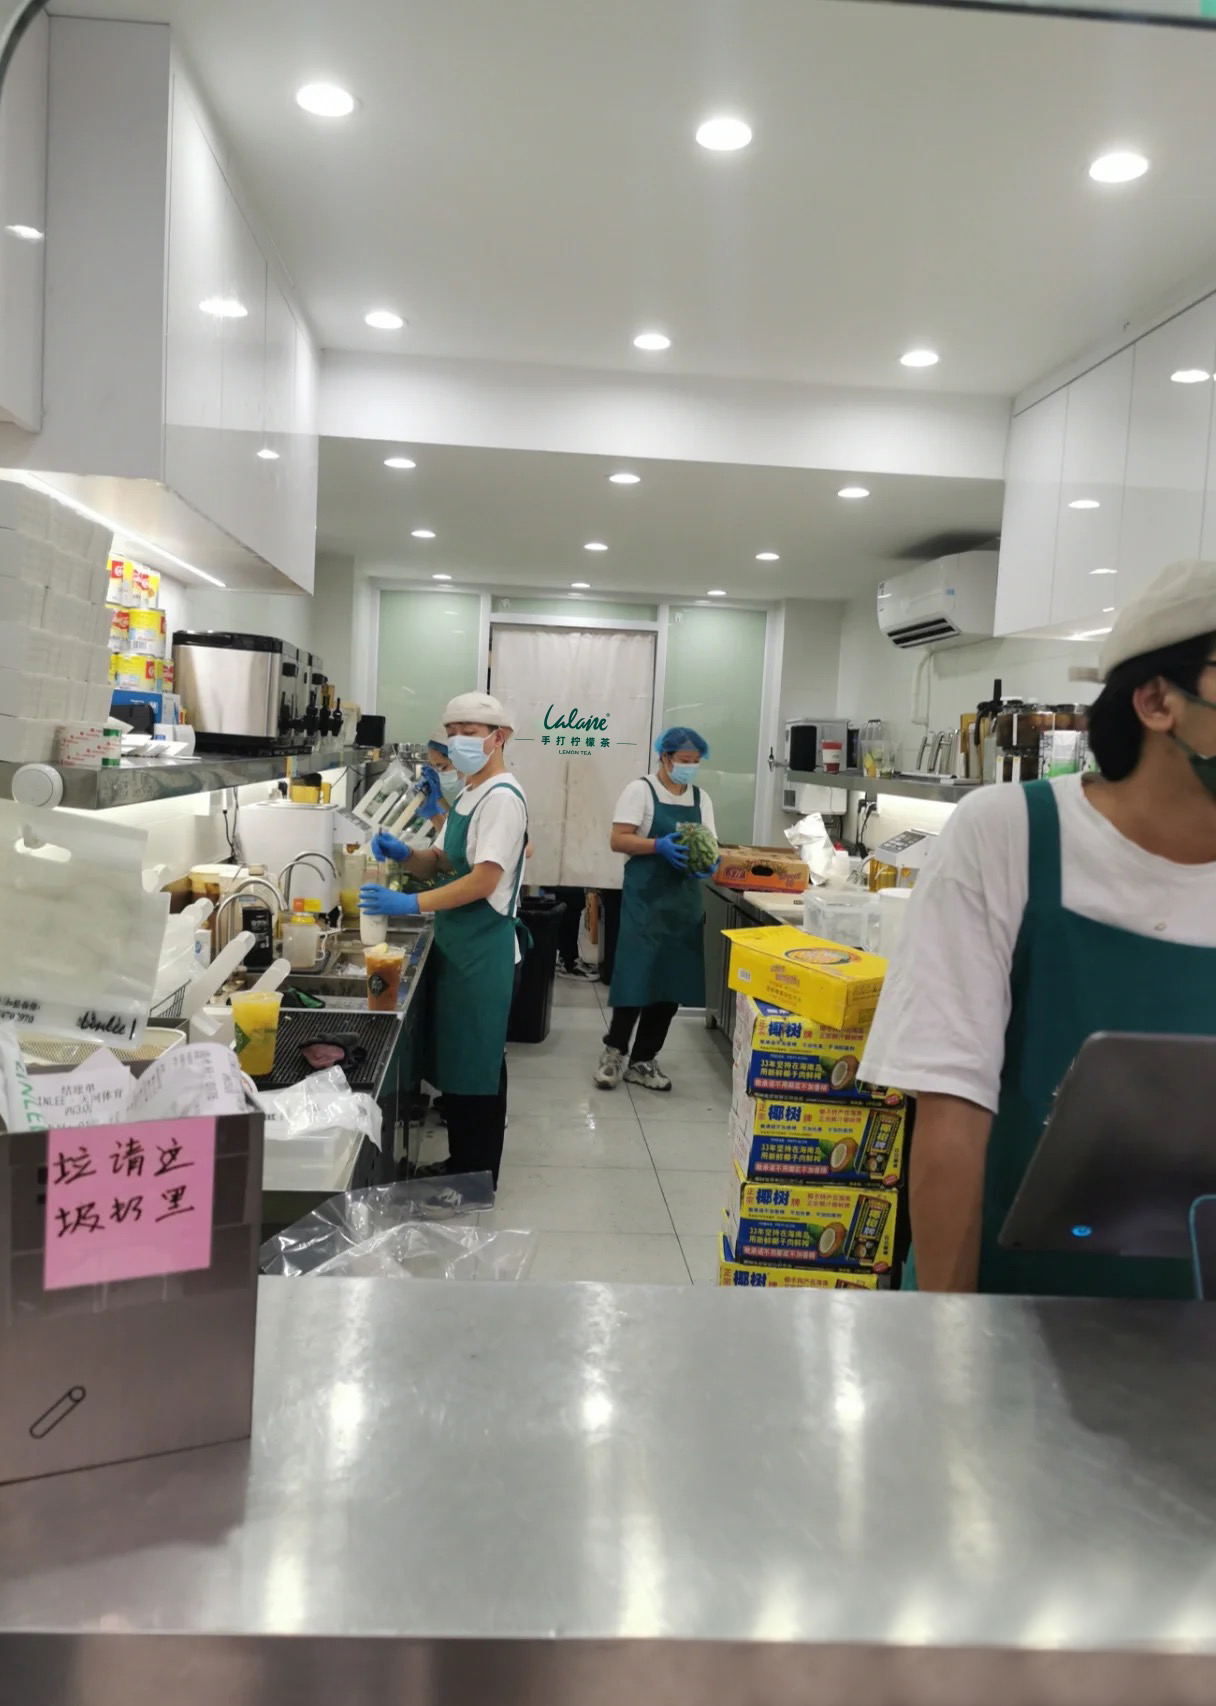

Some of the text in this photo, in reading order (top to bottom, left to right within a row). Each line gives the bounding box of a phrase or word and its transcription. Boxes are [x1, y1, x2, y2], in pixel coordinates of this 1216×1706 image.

[541, 735, 611, 748] 手打柠檬茶
